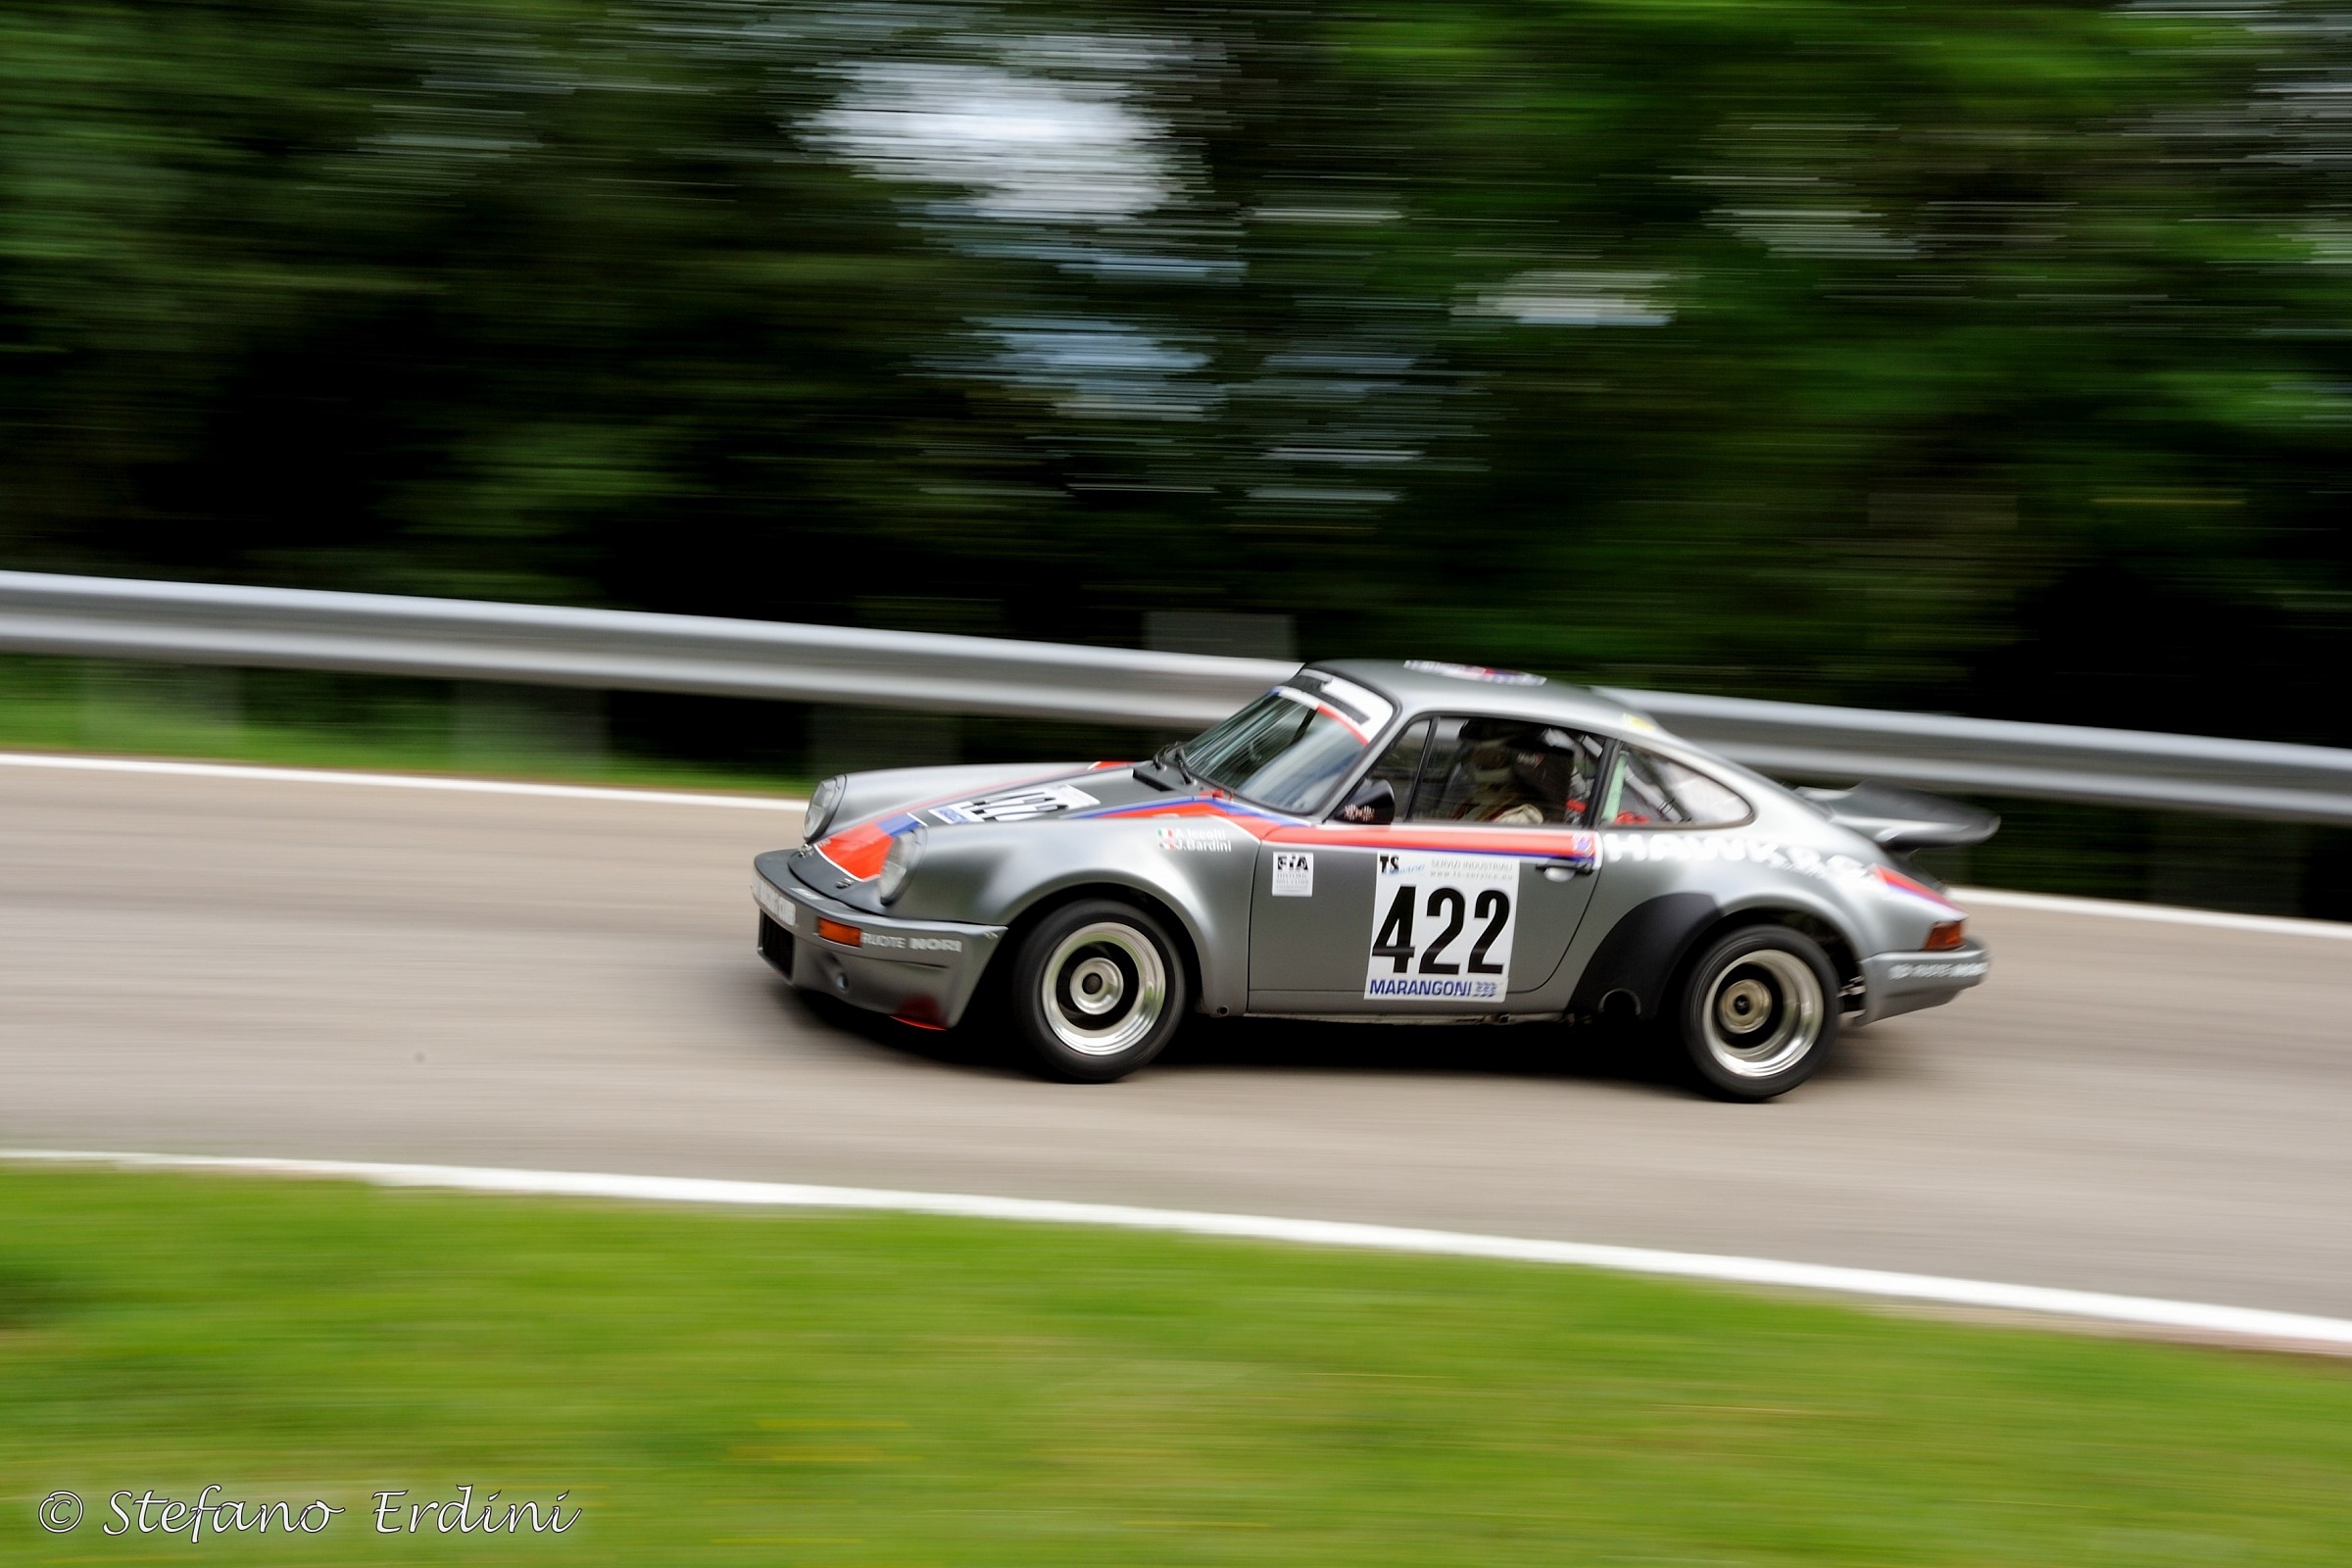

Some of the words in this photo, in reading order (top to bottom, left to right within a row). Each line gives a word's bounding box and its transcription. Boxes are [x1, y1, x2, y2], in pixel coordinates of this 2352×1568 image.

[1372, 885, 1510, 975] 422
[861, 931, 907, 949] RUOTE
[1369, 979, 1472, 997] MARANGONI
